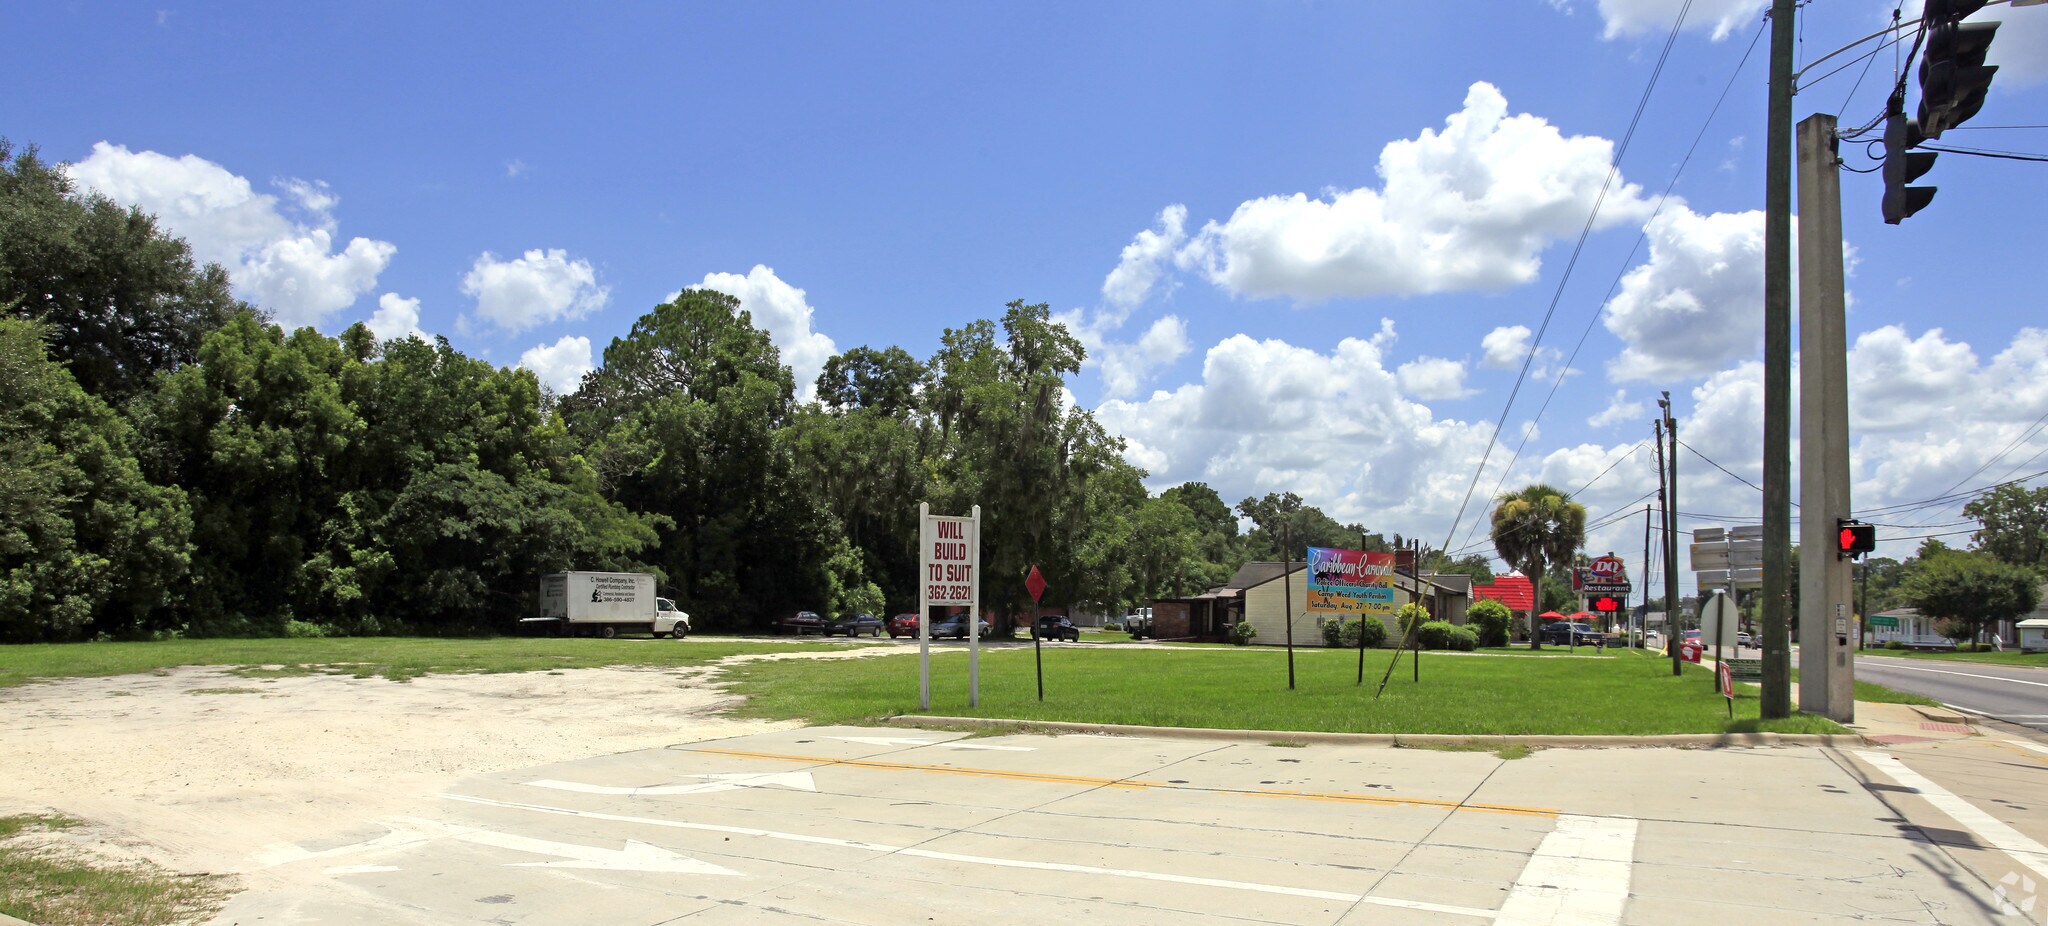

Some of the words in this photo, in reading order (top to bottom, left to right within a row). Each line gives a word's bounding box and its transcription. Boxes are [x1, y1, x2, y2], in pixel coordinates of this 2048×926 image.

[938, 521, 963, 539] WILL
[935, 542, 966, 560] BUILD
[1309, 550, 1356, 576] Caribbean
[1595, 561, 1619, 573] DQ
[928, 563, 942, 581] TO
[946, 563, 971, 582] SUIT
[928, 584, 971, 600] 362-2621
[1316, 578, 1333, 586] Police
[1360, 580, 1378, 590] Charity
[1317, 590, 1334, 598] Camp
